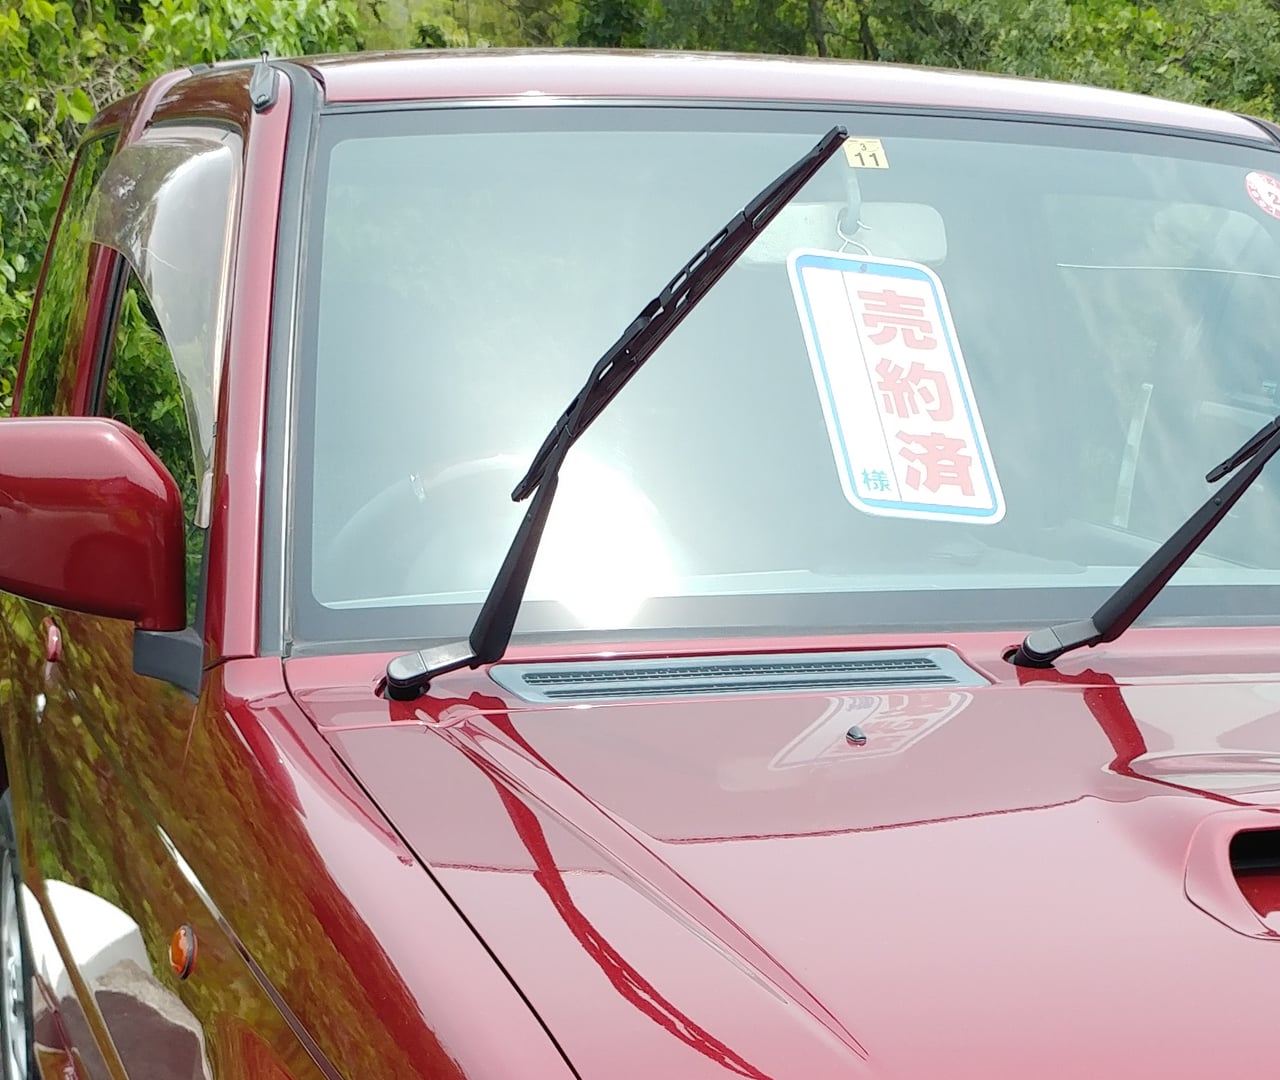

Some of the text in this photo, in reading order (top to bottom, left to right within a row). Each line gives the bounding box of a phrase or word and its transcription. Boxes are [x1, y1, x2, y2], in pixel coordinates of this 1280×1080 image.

[859, 143, 867, 151] 3
[854, 152, 880, 167] 11
[857, 289, 975, 496] 売約済
[861, 468, 891, 491] 様
